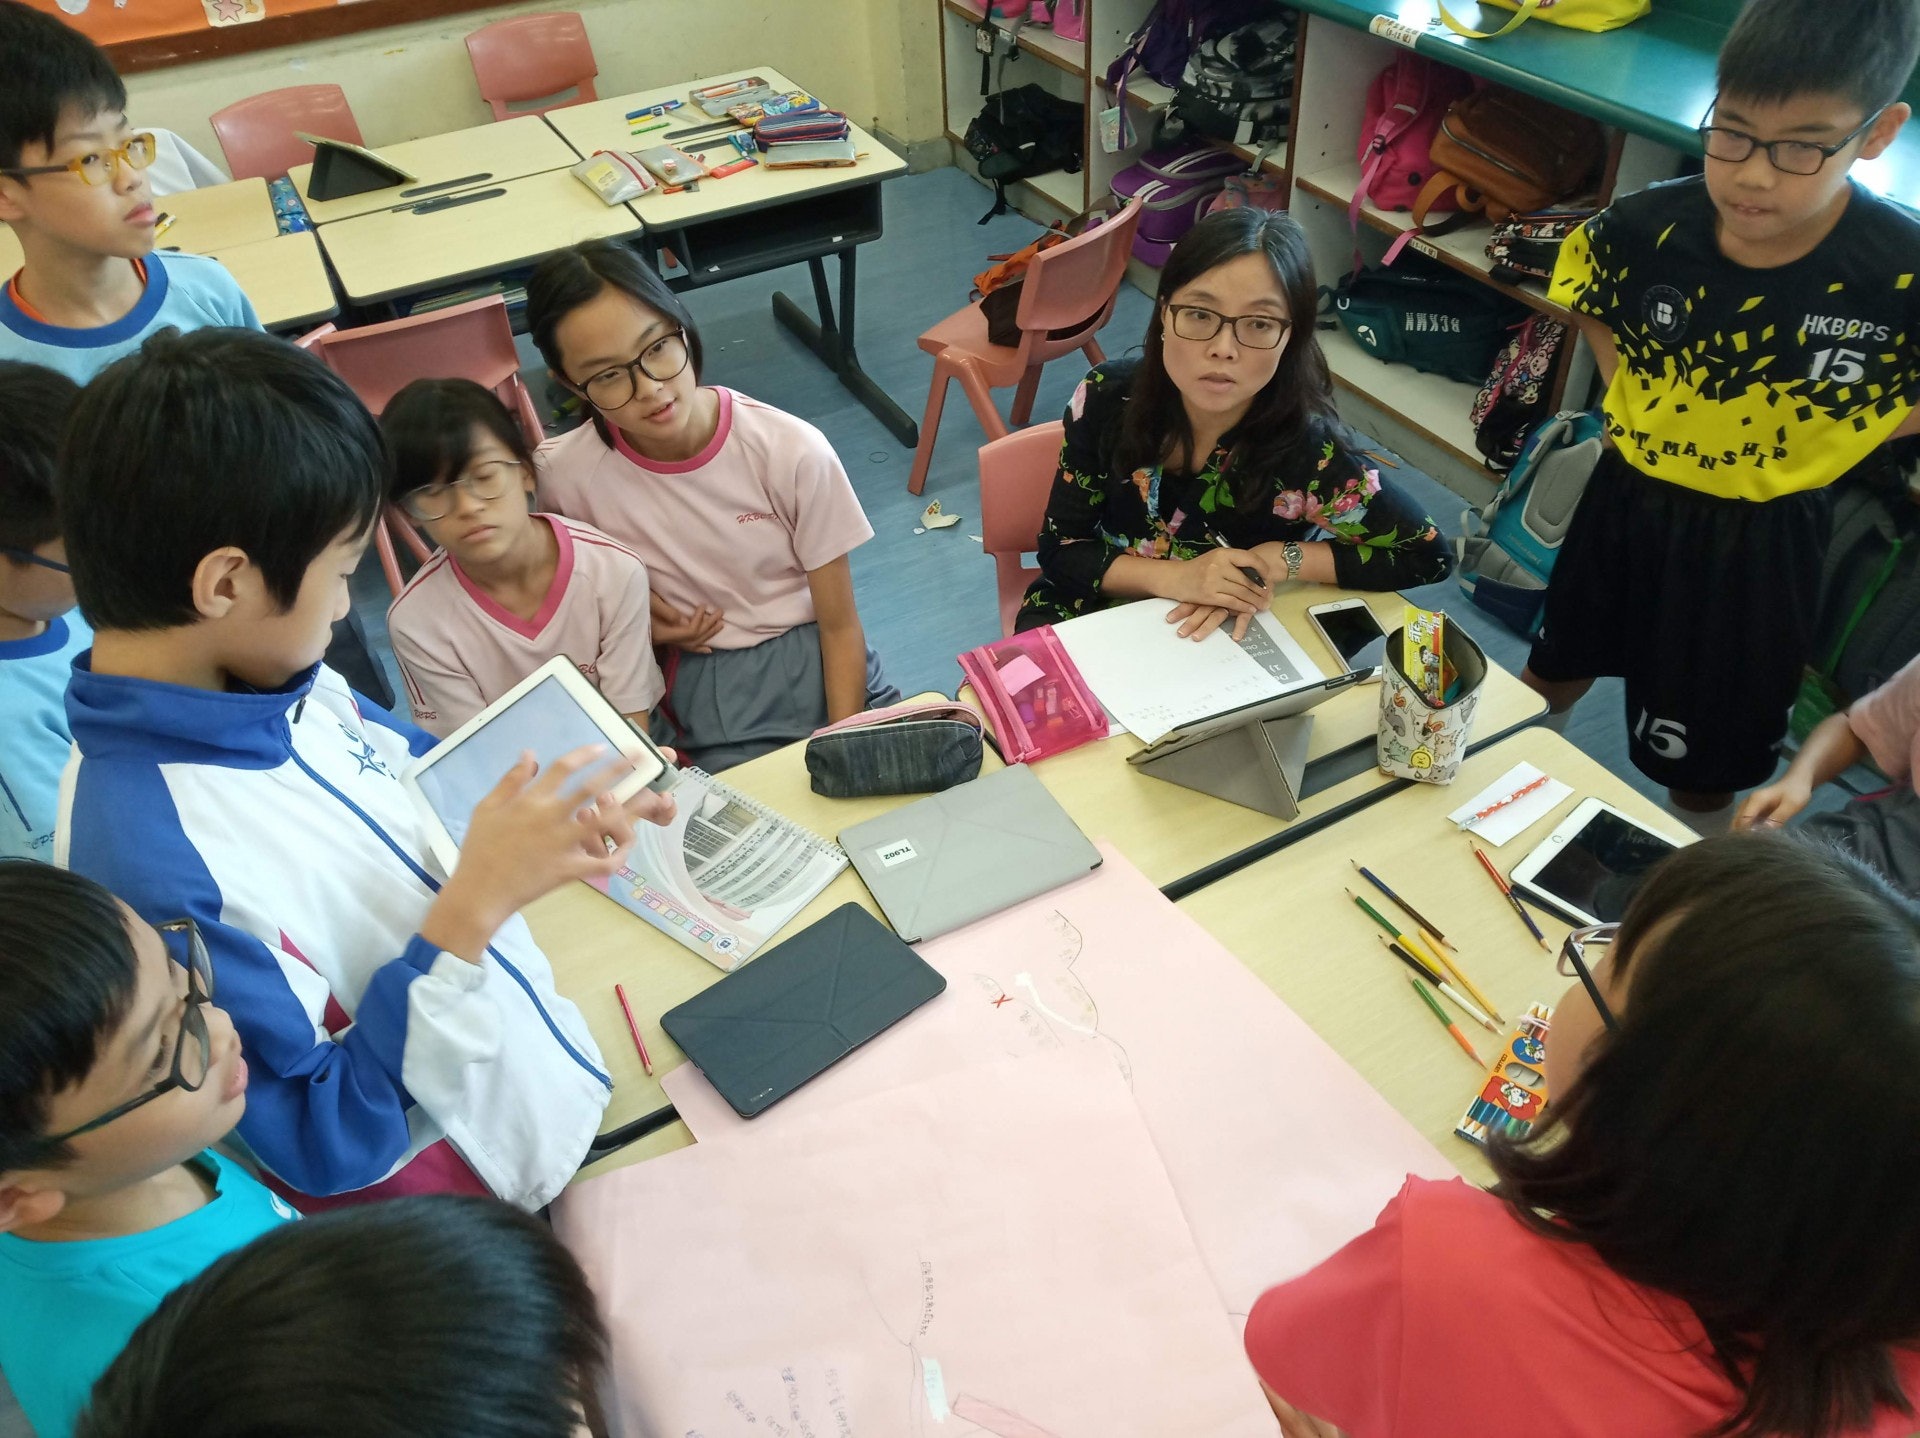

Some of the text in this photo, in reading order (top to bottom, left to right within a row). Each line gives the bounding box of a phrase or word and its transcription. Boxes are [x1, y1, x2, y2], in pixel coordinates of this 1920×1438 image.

[1803, 313, 1890, 342] HKBCPS
[1806, 347, 1866, 383] 15
[1634, 706, 1688, 759] 15
[883, 846, 911, 860] TL902
